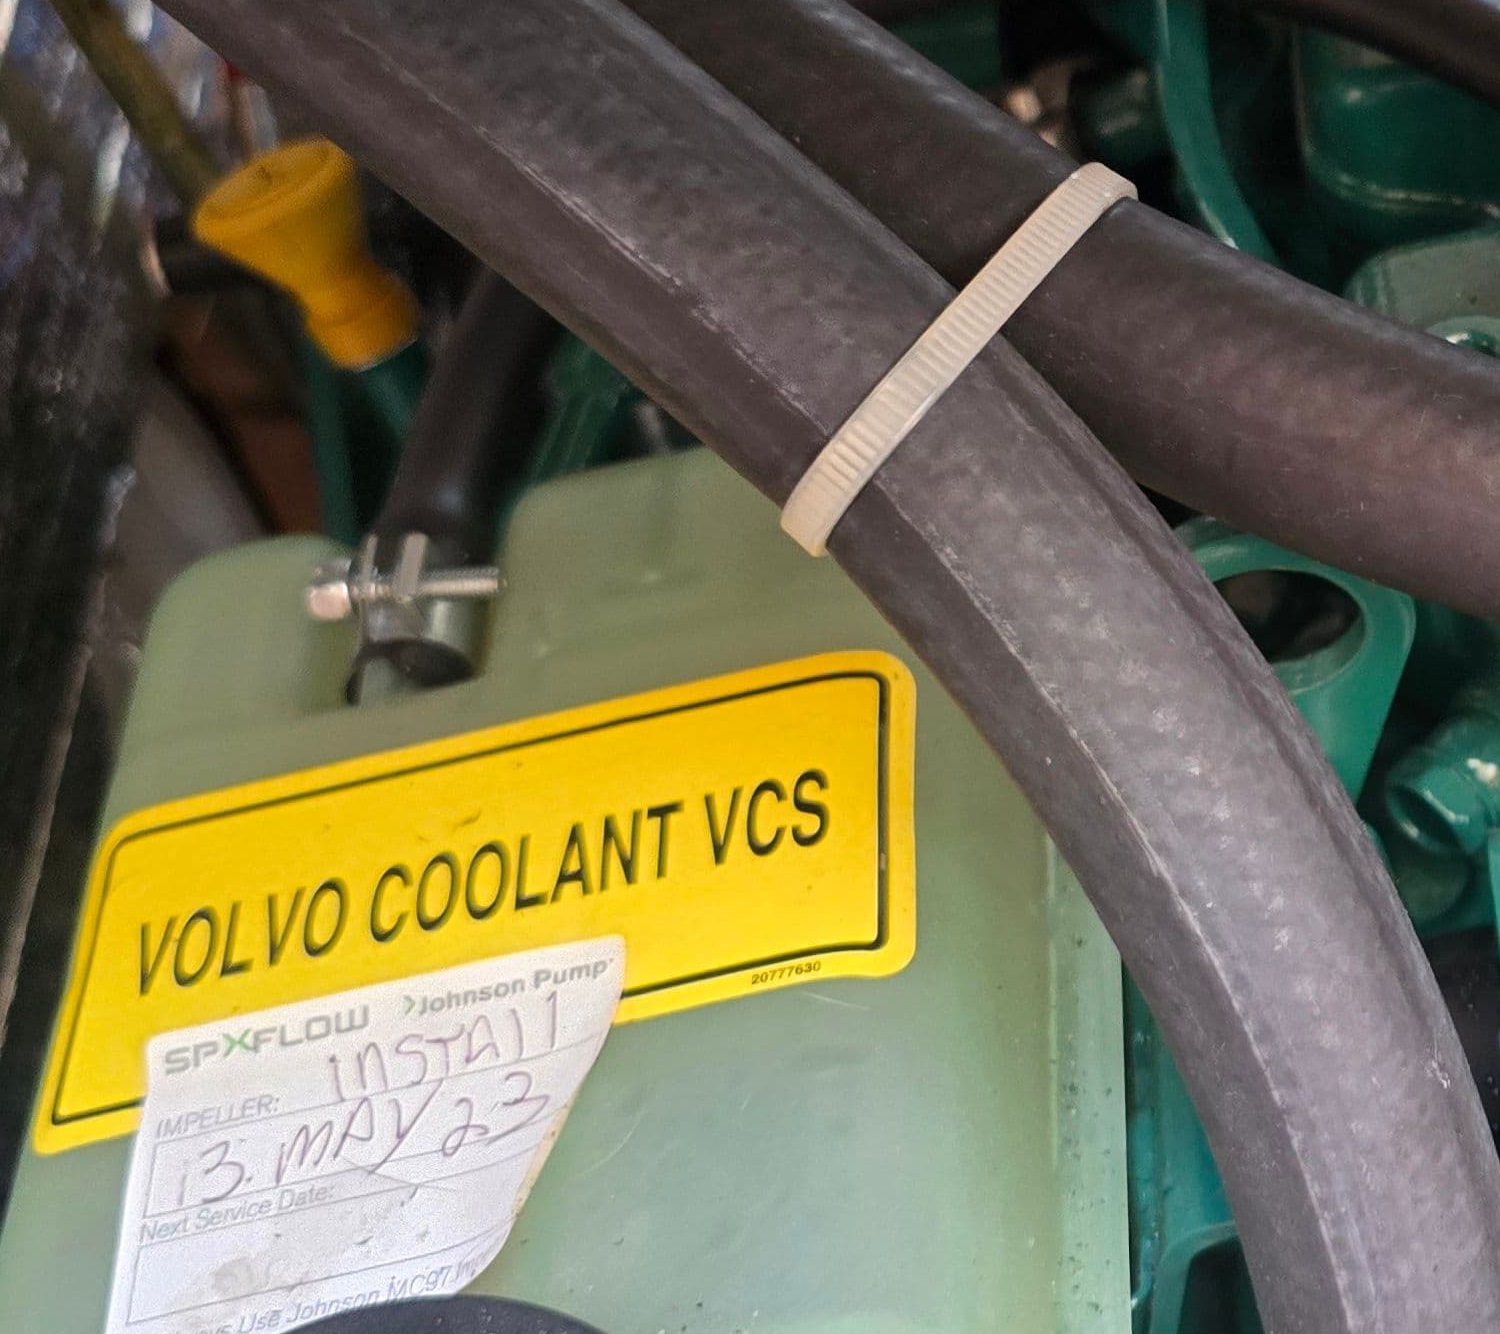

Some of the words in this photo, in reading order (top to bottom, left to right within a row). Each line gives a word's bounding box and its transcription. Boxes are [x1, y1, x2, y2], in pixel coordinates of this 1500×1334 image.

[138, 878, 350, 996] VOLVO
[369, 801, 683, 944] COOLANT
[704, 769, 830, 865] VCS
[417, 978, 526, 1016] Johnson
[532, 958, 608, 990] Pump
[751, 961, 822, 985] 20777630
[155, 1093, 280, 1139] IMPELLER:
[275, 1079, 445, 1185] MAY
[138, 1215, 189, 1243] Next
[195, 1200, 273, 1230] Service
[277, 1185, 334, 1212] Date:
[238, 1308, 283, 1333] Use
